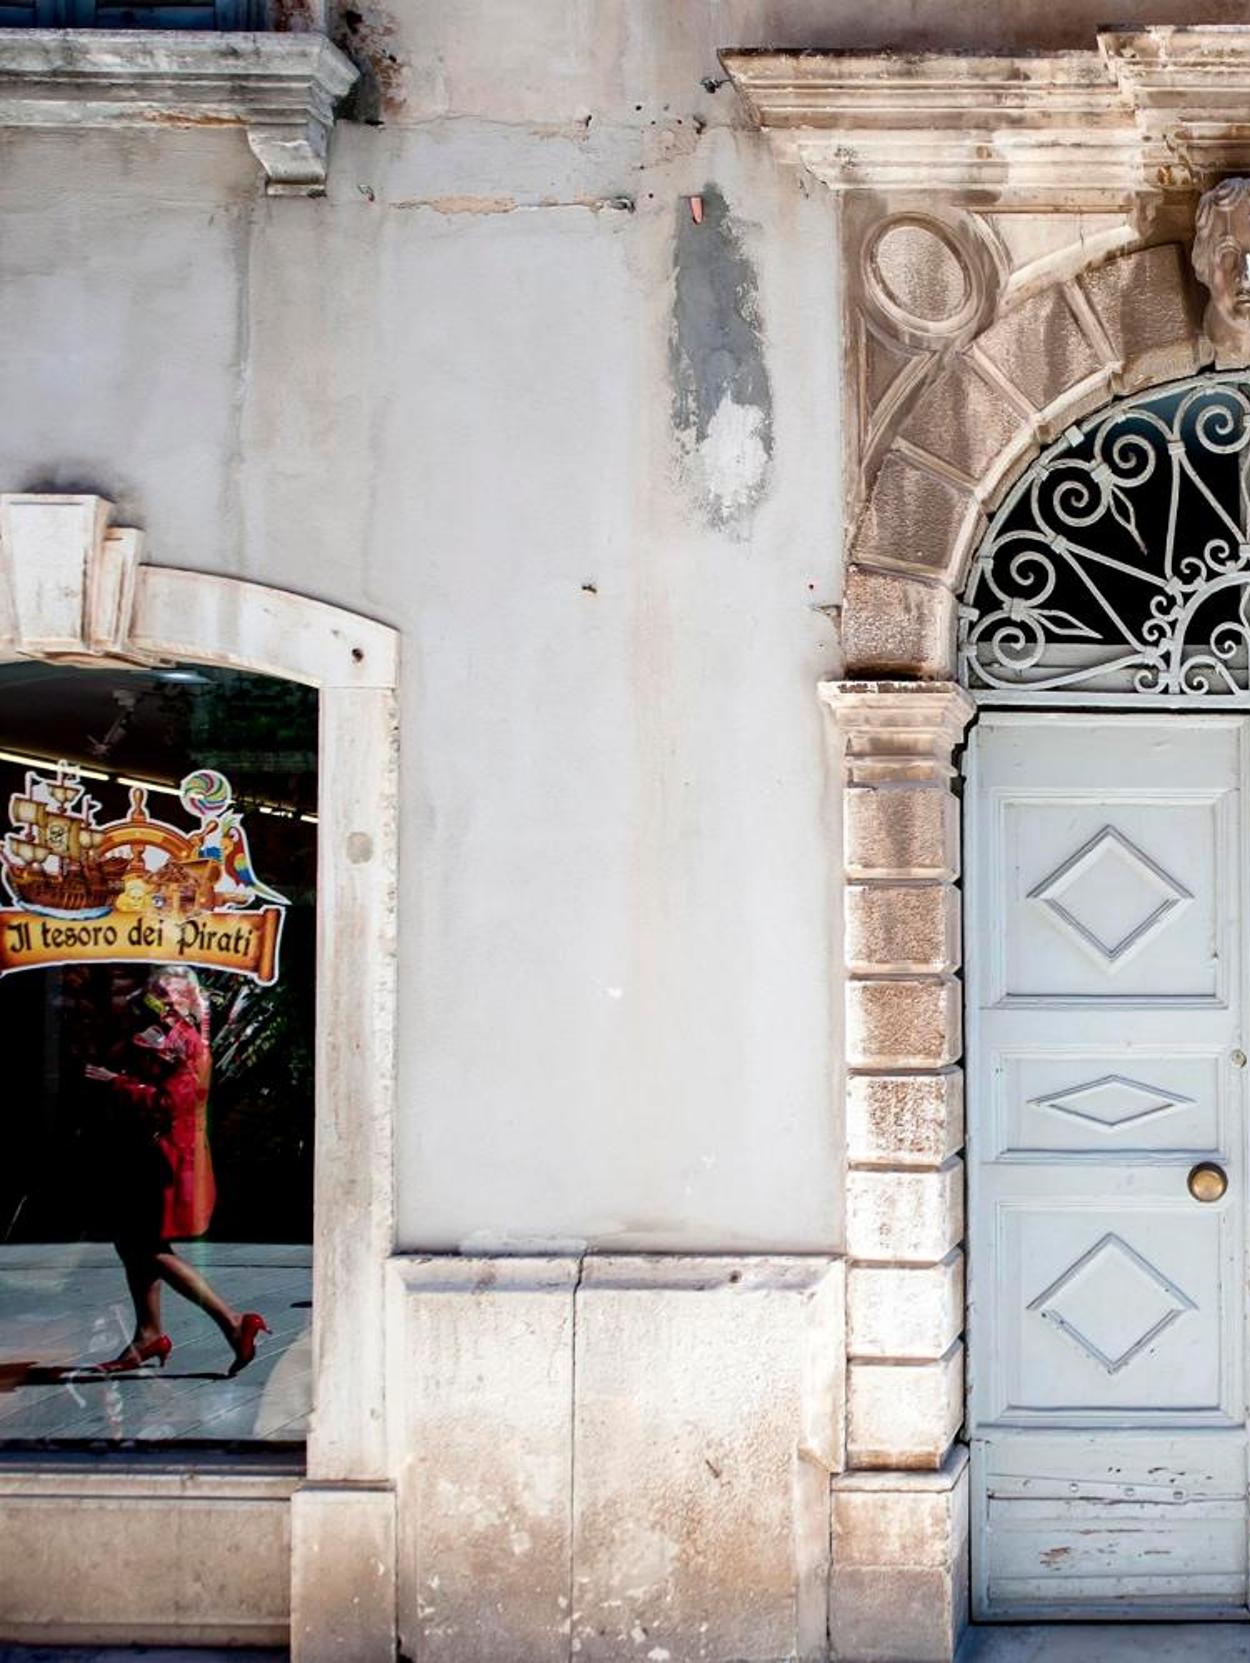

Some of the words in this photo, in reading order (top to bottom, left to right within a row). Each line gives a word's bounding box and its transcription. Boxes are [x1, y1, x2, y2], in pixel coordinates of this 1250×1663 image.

[10, 922, 32, 952] Il
[41, 921, 118, 949] tesoro
[128, 917, 164, 946] dei
[176, 919, 254, 957] Pirati
